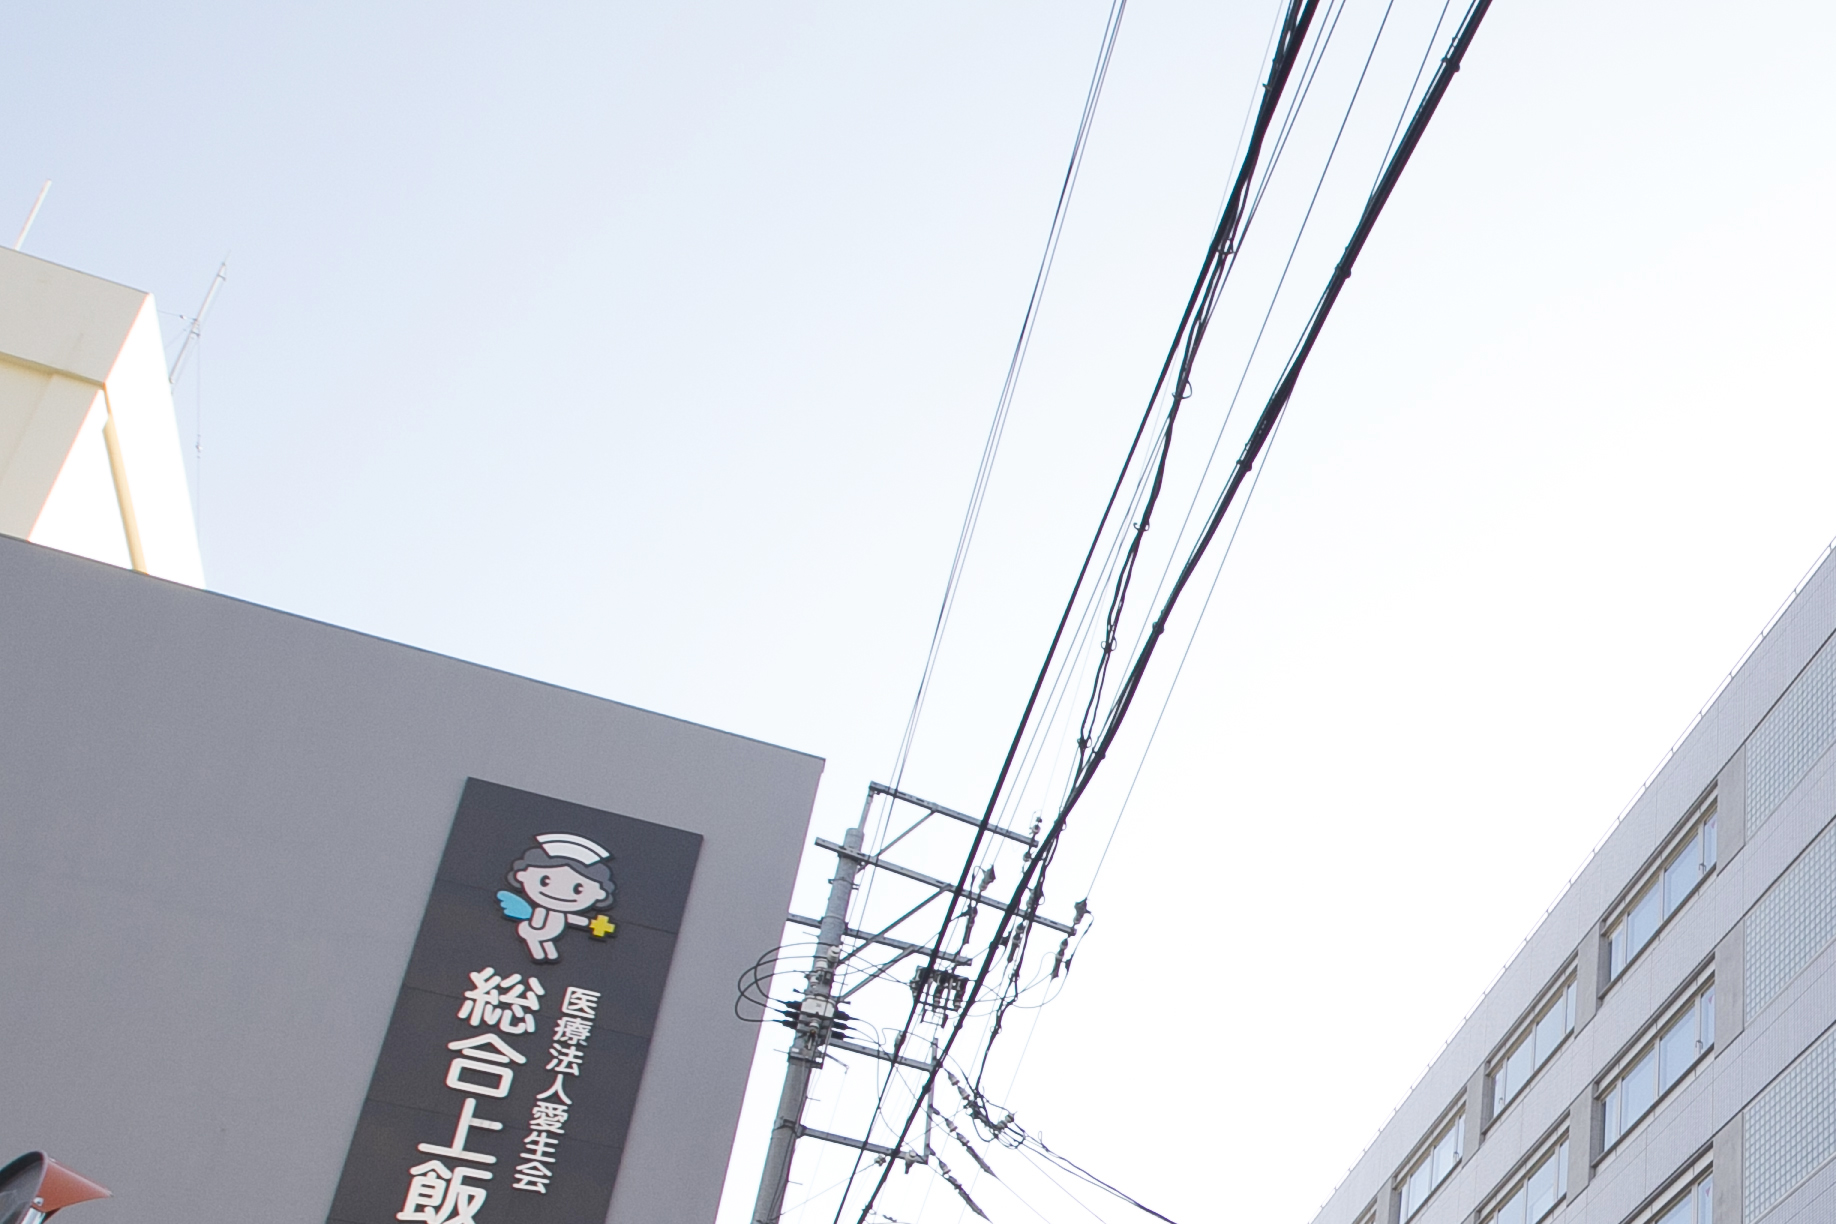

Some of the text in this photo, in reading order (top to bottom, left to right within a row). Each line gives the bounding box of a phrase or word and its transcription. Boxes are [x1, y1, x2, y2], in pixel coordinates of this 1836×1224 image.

[512, 985, 601, 1195] 医療法人愛生会
